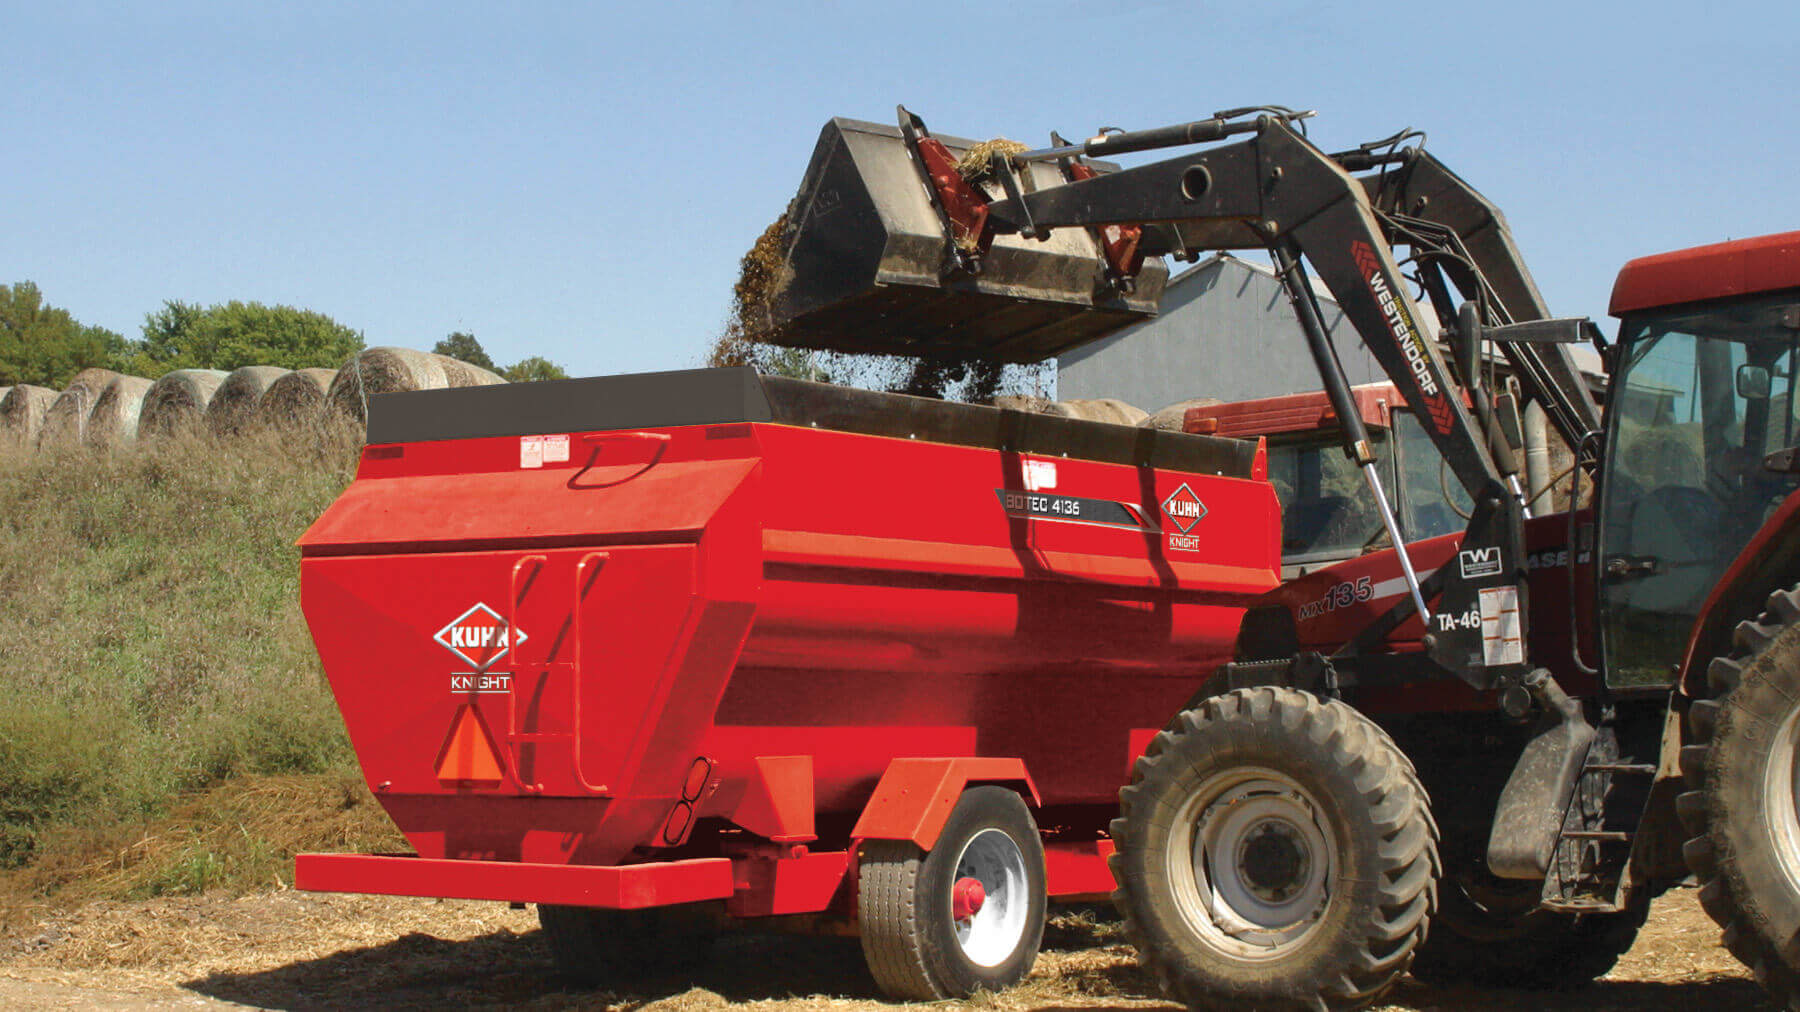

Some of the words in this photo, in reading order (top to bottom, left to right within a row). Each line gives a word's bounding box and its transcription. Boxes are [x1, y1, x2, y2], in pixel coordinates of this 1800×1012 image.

[1371, 272, 1438, 395] WESTENDORF
[1052, 499, 1080, 515] 4136
[1170, 500, 1200, 517] KUHN
[1170, 536, 1200, 548] KNIGHT
[1528, 551, 1568, 568] ASE
[1437, 610, 1481, 631] TA-46
[451, 626, 509, 648] KUHN
[451, 676, 510, 689] KNIGHT
